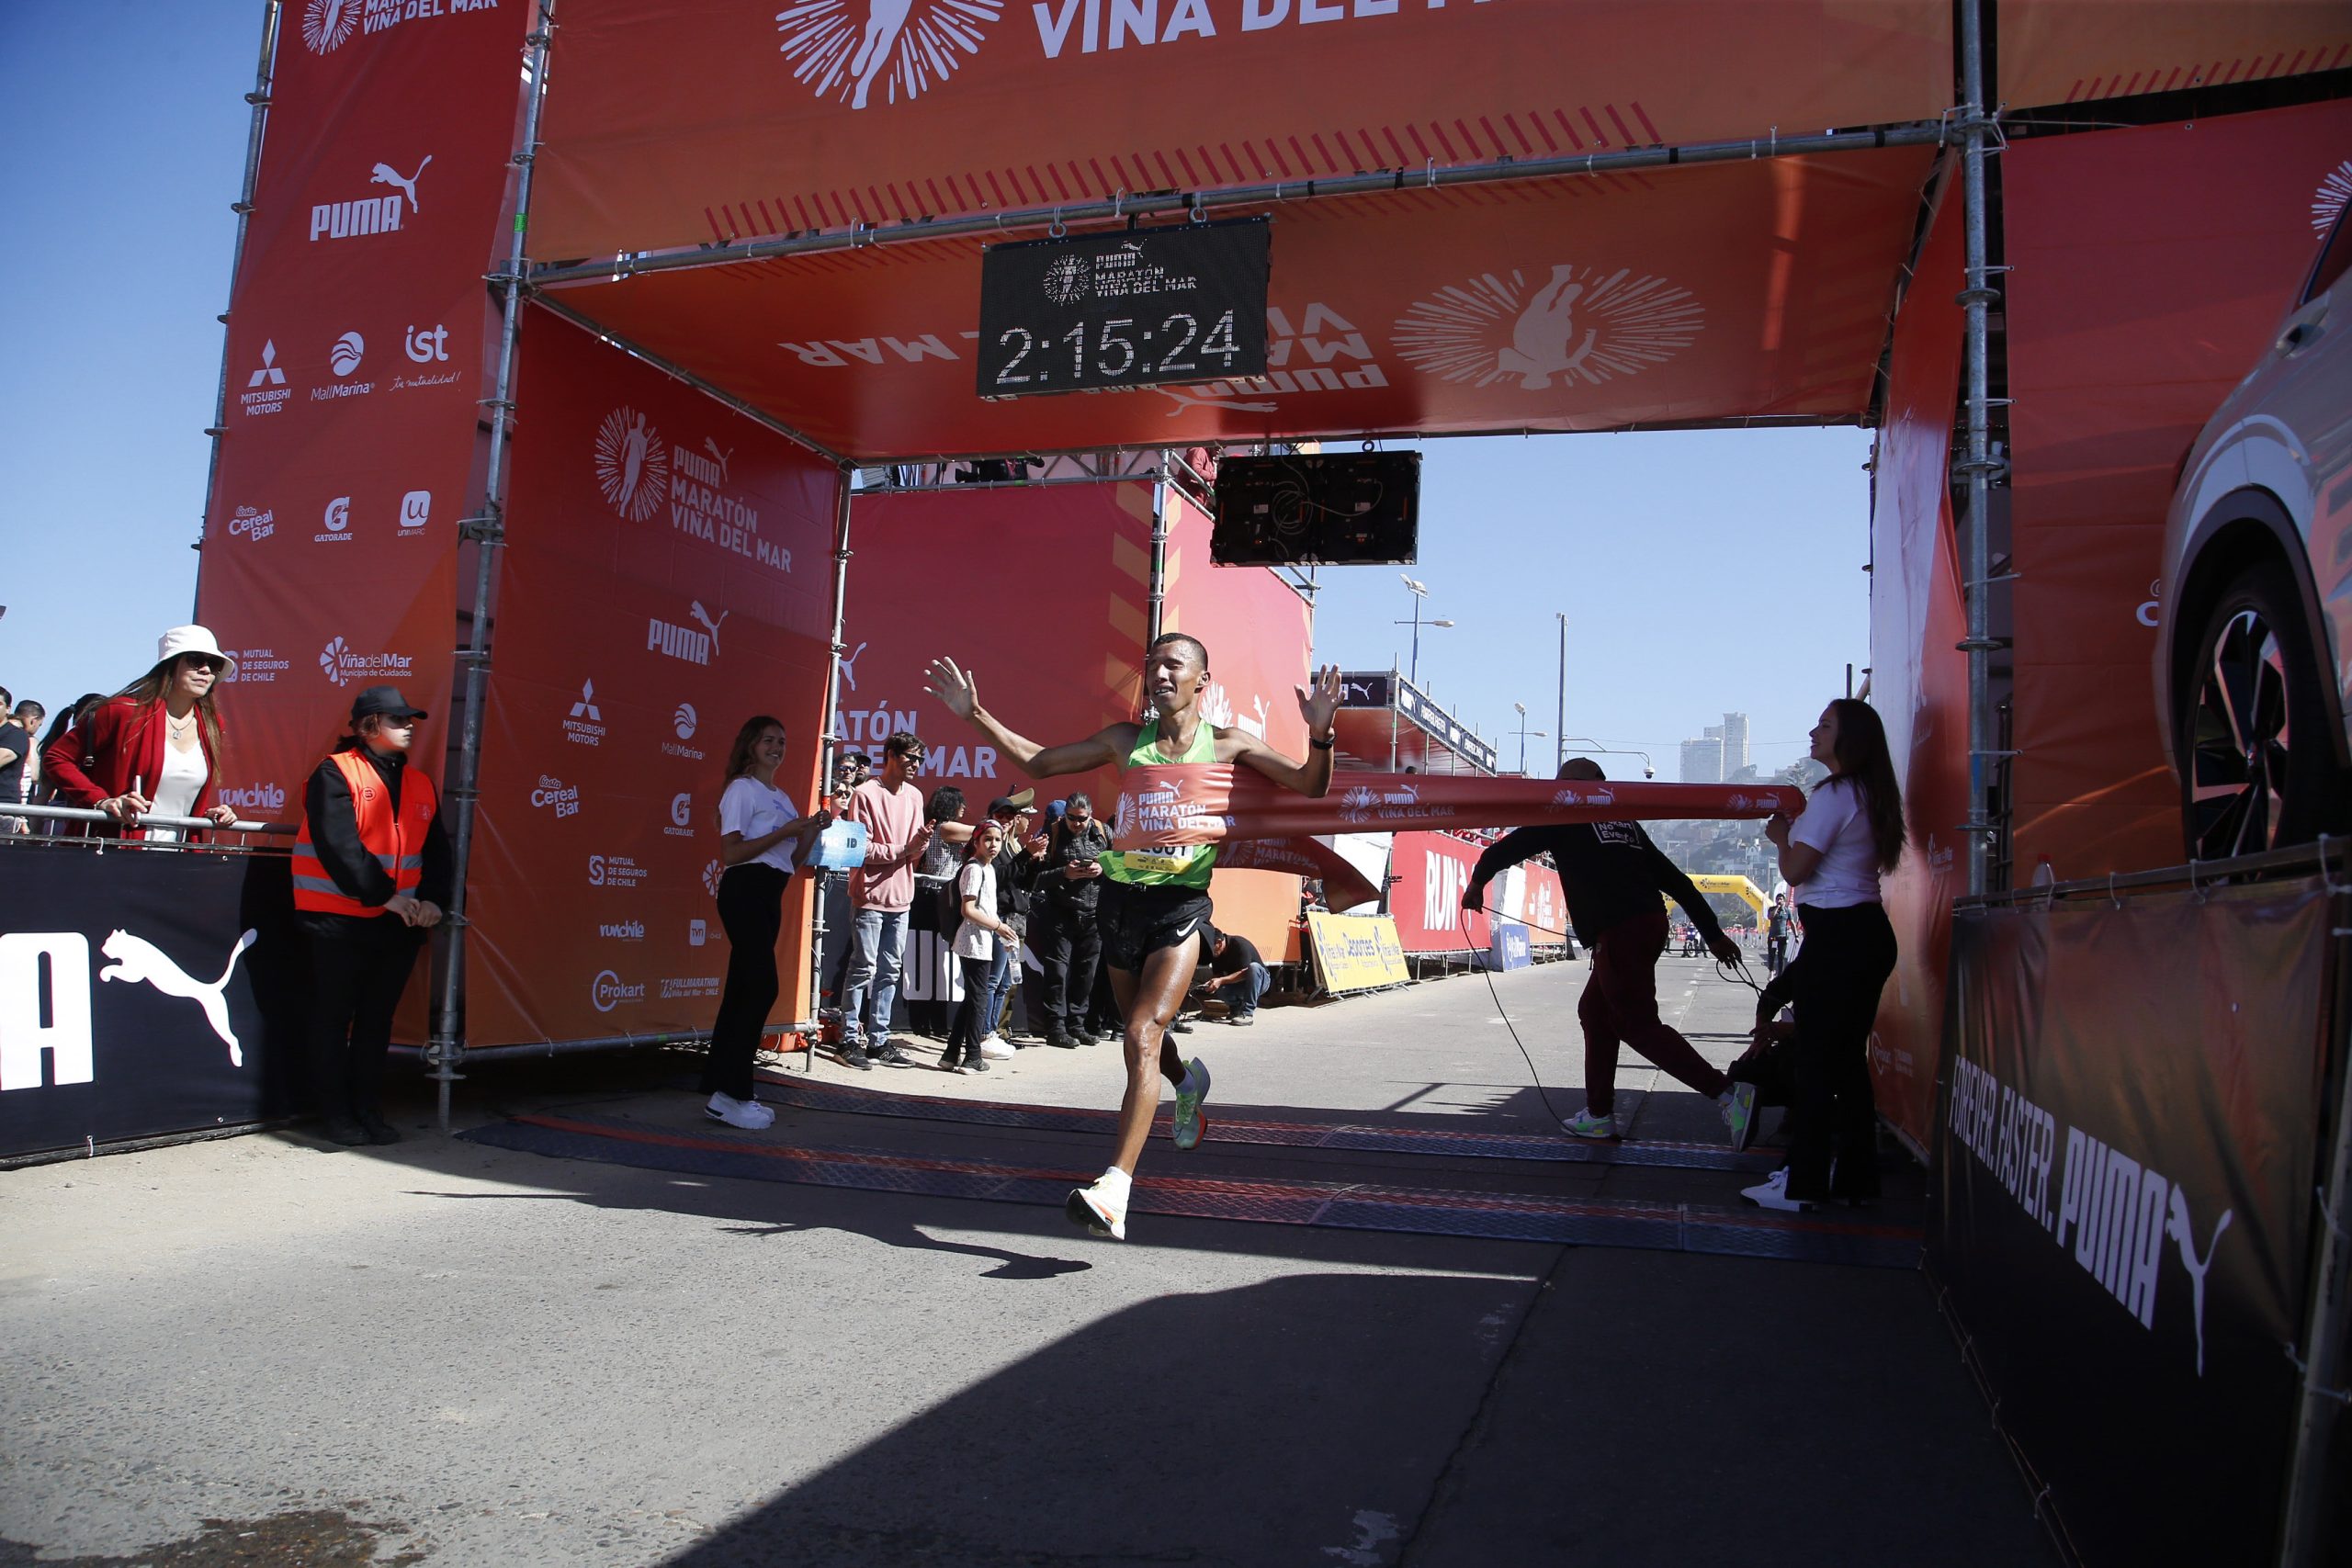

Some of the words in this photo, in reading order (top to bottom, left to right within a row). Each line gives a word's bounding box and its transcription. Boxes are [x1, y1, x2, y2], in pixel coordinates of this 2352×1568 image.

[405, 0, 444, 19] DEL
[309, 195, 401, 241] PUMA
[1096, 253, 1135, 269] PUMA
[1134, 280, 1159, 294] DEL
[1165, 276, 1196, 290] MAR
[405, 324, 448, 363] ist
[997, 310, 1240, 384] 2:15:24
[241, 389, 291, 404] MITSUBISHI
[246, 401, 282, 416] MOTORS
[673, 445, 720, 489] PUMA
[671, 475, 757, 534] MARATÓN
[229, 510, 273, 536] Cereal
[252, 523, 274, 541] Bar
[314, 532, 353, 543] GATORADE
[671, 502, 715, 544] VIÑA
[719, 525, 752, 558] DEL
[756, 538, 791, 573] MAR
[647, 617, 709, 666] PUMA
[243, 649, 274, 659] MUTUAL
[243, 660, 253, 670] DE
[254, 660, 289, 670] SEGUROS
[241, 673, 251, 682] DE
[253, 672, 275, 682] CHILE
[340, 670, 368, 678] Municipio
[562, 719, 606, 736] MITSUBISHI
[835, 700, 917, 740] ATÓN
[567, 732, 599, 746] MOTORS
[922, 746, 997, 778] MAR
[531, 785, 578, 807] Cereal
[1139, 792, 1173, 805] PUMA
[1385, 793, 1414, 805] PUMA
[1587, 795, 1611, 806] PUMA
[556, 802, 579, 818] Bar
[1139, 801, 1206, 818] MARATÓN
[663, 827, 695, 837] GATORADE
[1139, 818, 1174, 832] VIÑA
[608, 856, 635, 865] MUTUAL
[607, 867, 617, 875] DE
[618, 868, 648, 877] SEGUROS
[617, 878, 636, 886] CHILE
[1424, 850, 1458, 931] RUN
[600, 983, 645, 998] Prokart
[1996, 1085, 2055, 1233] FASTER.
[2056, 1125, 2168, 1331] PUMA
